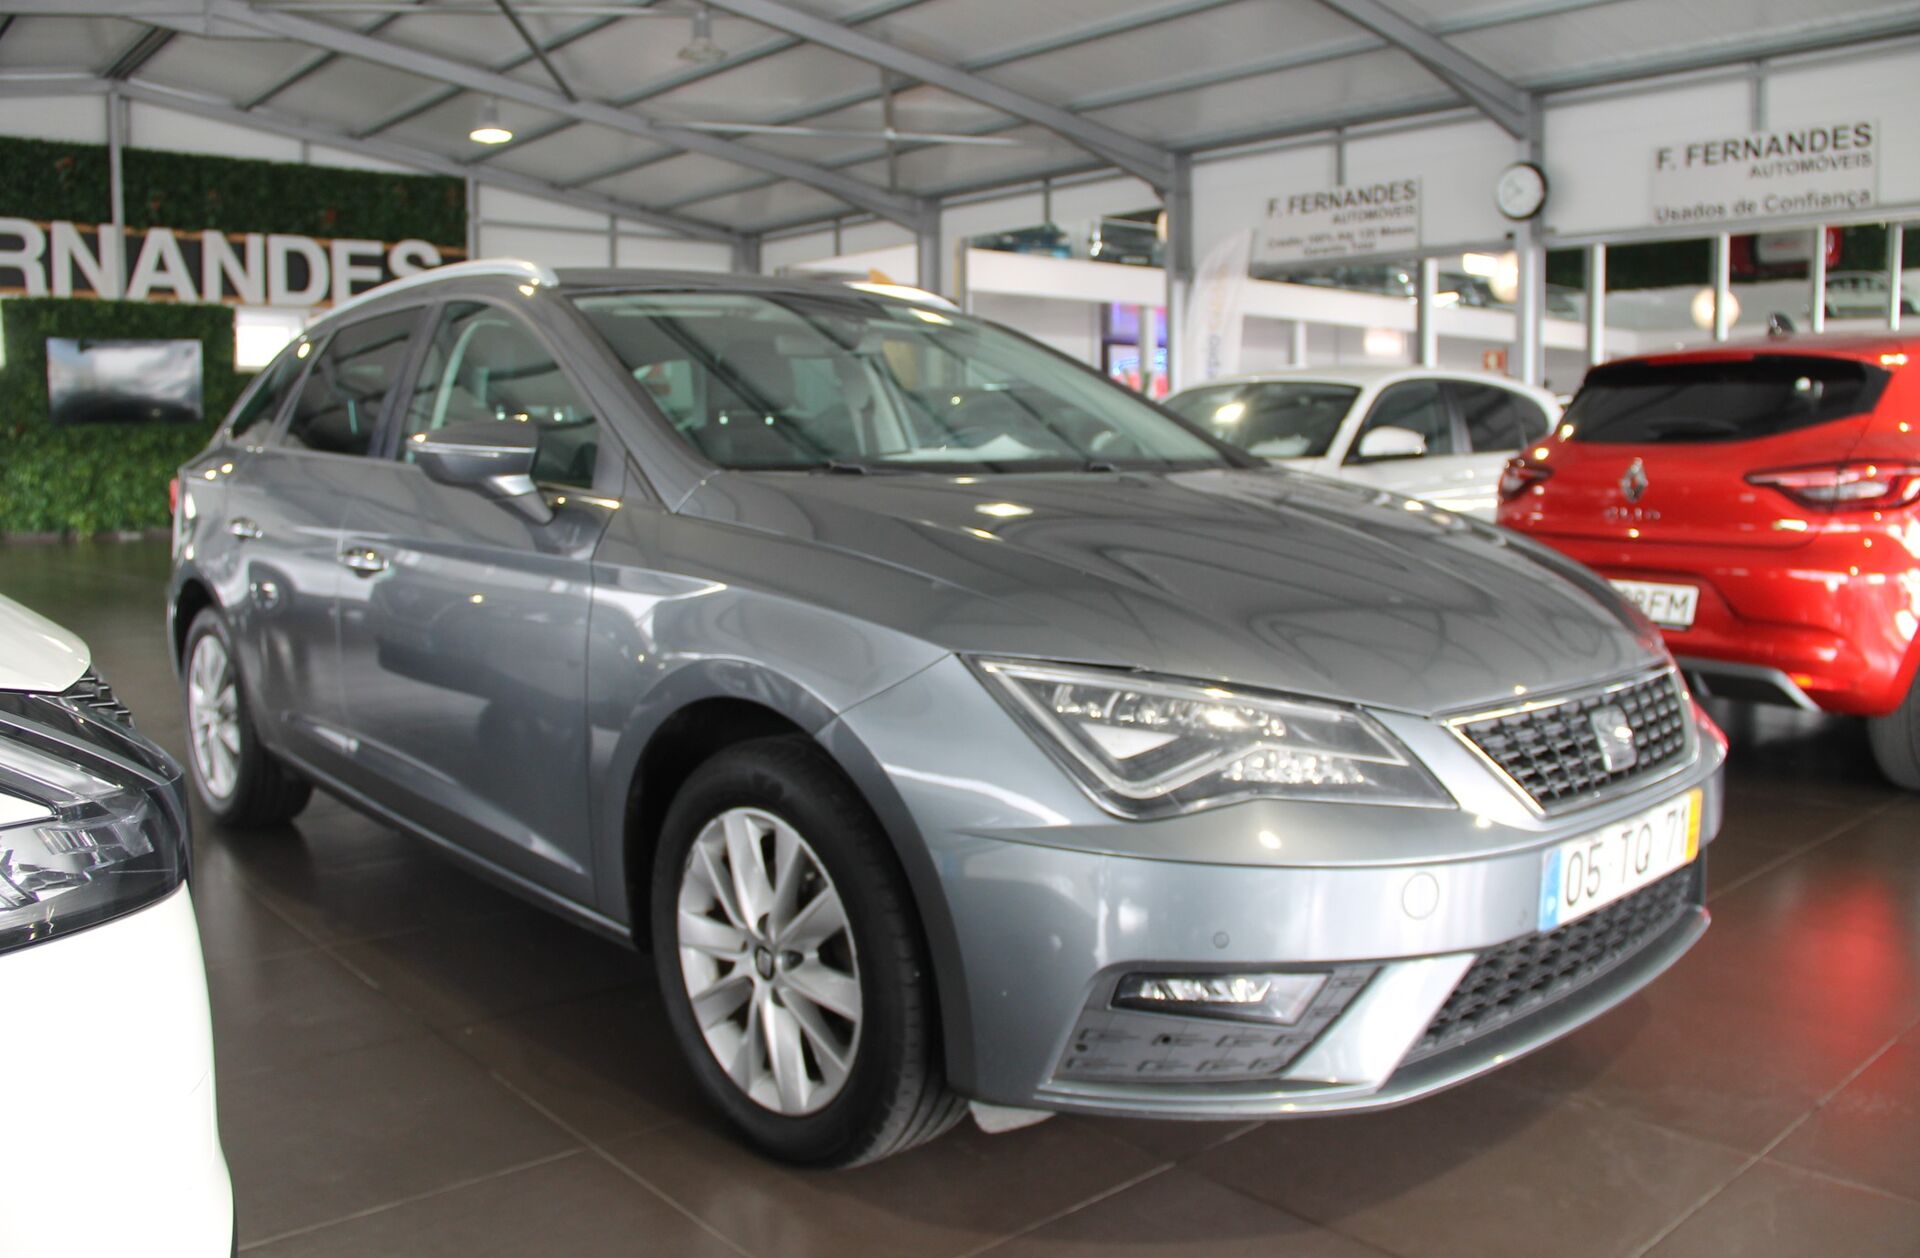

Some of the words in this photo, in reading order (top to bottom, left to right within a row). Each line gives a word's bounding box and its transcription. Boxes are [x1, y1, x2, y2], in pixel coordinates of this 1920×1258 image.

[1655, 147, 1677, 172] F.
[1686, 122, 1873, 168] FERNANDES
[1266, 196, 1284, 217] F.
[1288, 179, 1417, 216] FERNANDES
[1655, 202, 1727, 224] Usados
[1734, 198, 1758, 216] de
[1764, 188, 1872, 213] Confiança
[1566, 841, 1603, 907] 05
[1667, 805, 1688, 863] 71
